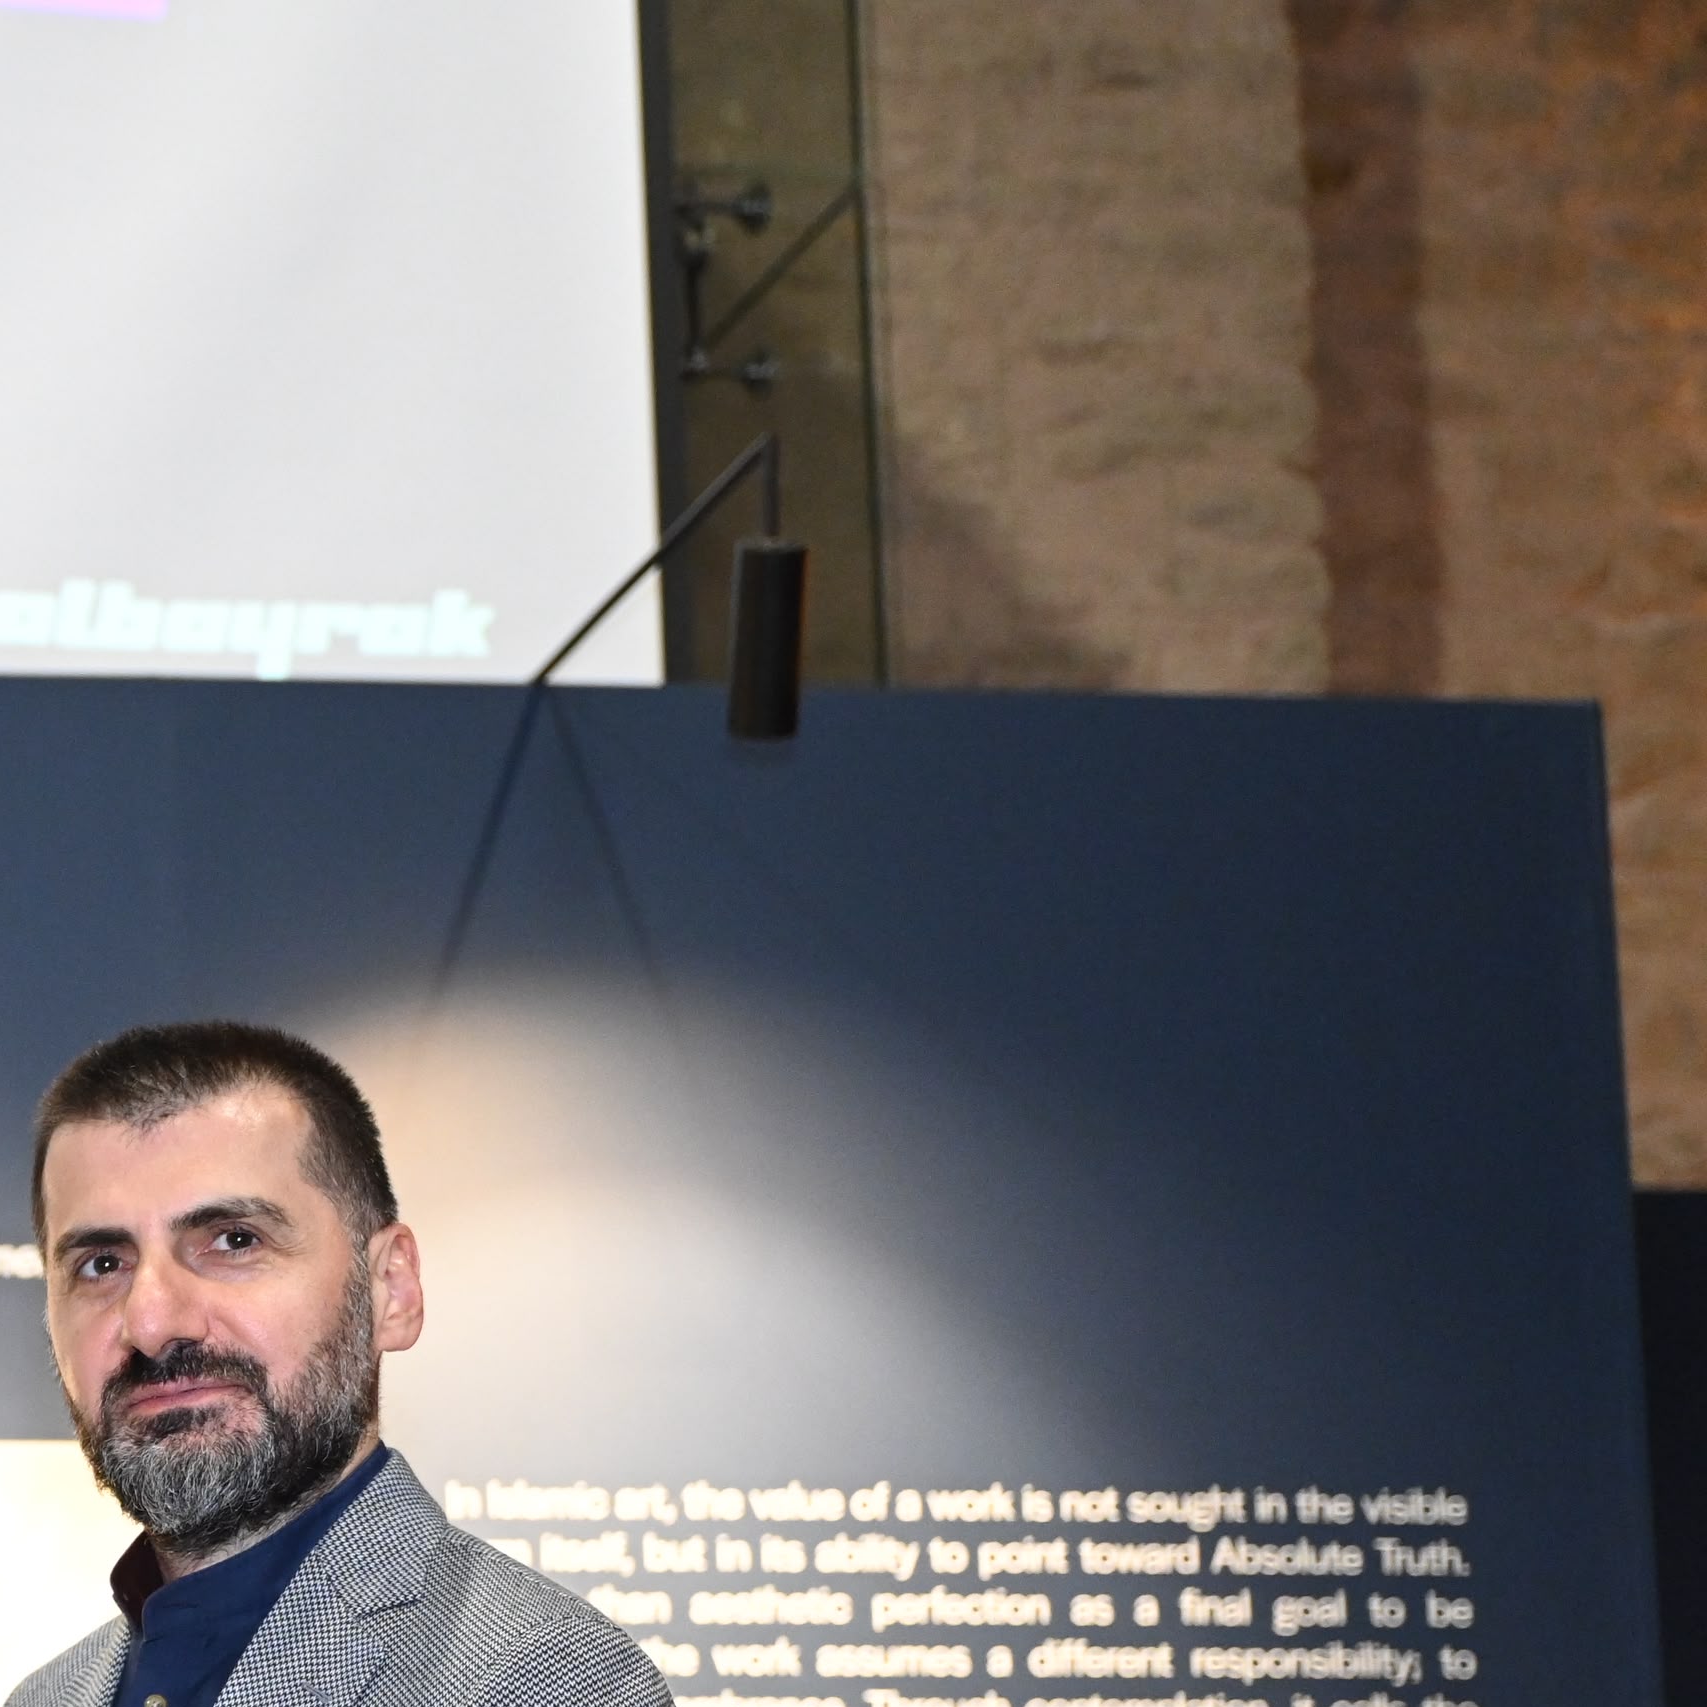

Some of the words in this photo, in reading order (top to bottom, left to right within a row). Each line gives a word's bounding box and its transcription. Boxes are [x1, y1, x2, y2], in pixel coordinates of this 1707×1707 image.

[1022, 1483, 1053, 1524] is
[1060, 1486, 1119, 1524] not
[1126, 1484, 1245, 1533] sought
[1255, 1491, 1287, 1523] in
[1296, 1486, 1353, 1525] the
[1361, 1487, 1467, 1526] visible
